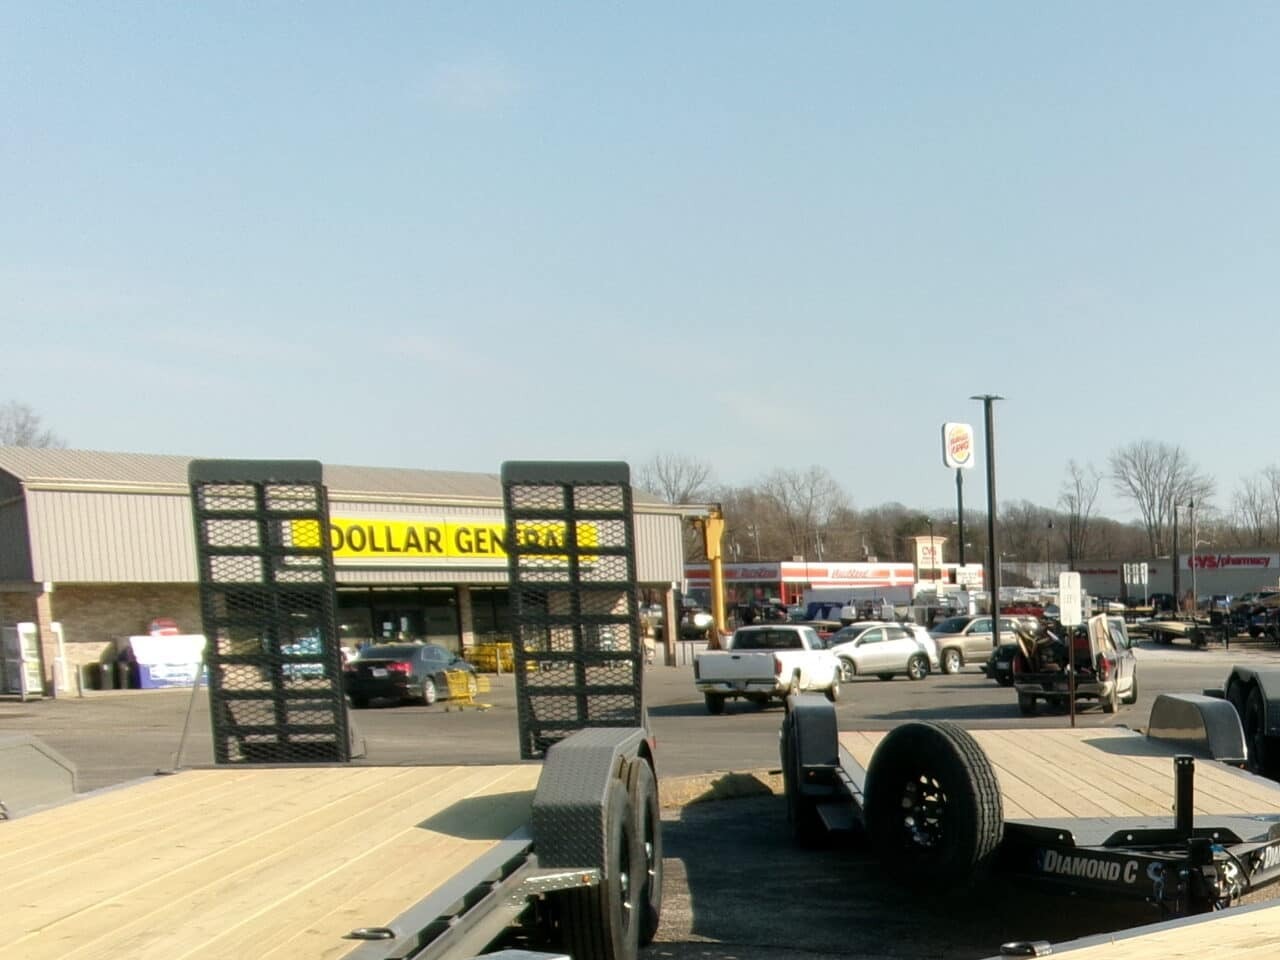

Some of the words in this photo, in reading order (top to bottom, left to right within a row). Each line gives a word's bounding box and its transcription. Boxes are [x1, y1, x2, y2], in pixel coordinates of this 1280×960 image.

[328, 524, 443, 553] DOLLAR
[455, 526, 572, 555] GENRA
[1043, 849, 1120, 881] DIAMOND
[1123, 860, 1139, 884] C
